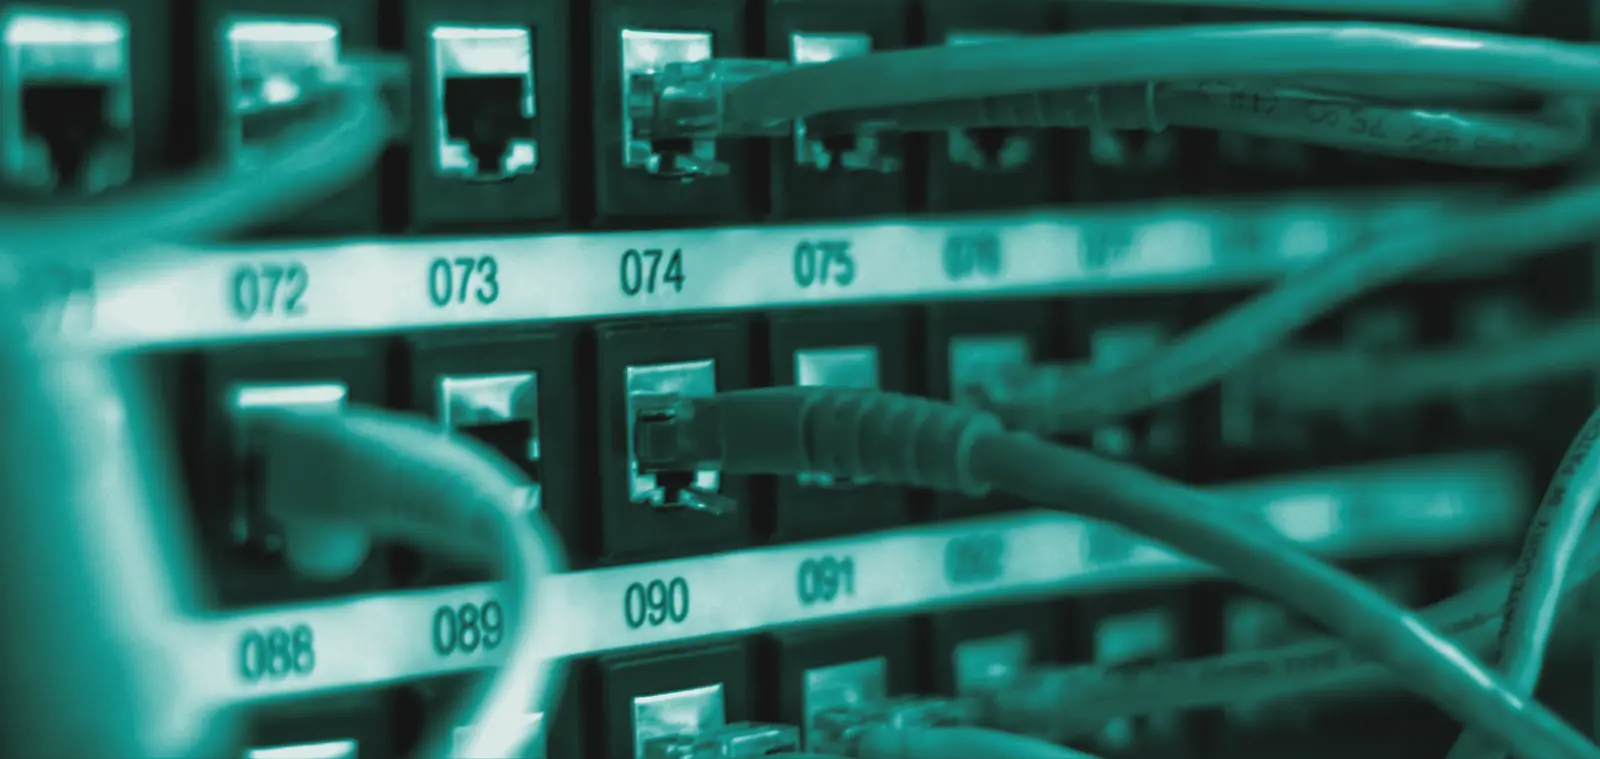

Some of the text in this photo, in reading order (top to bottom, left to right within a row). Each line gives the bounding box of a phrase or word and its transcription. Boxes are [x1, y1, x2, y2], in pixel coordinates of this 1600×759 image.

[227, 258, 309, 316] 072
[427, 255, 500, 307] 073
[620, 248, 685, 297] 074
[792, 239, 855, 288] 075
[623, 577, 690, 630] 090
[797, 555, 855, 606] 091
[237, 624, 315, 681] 088
[432, 600, 505, 656] 089
